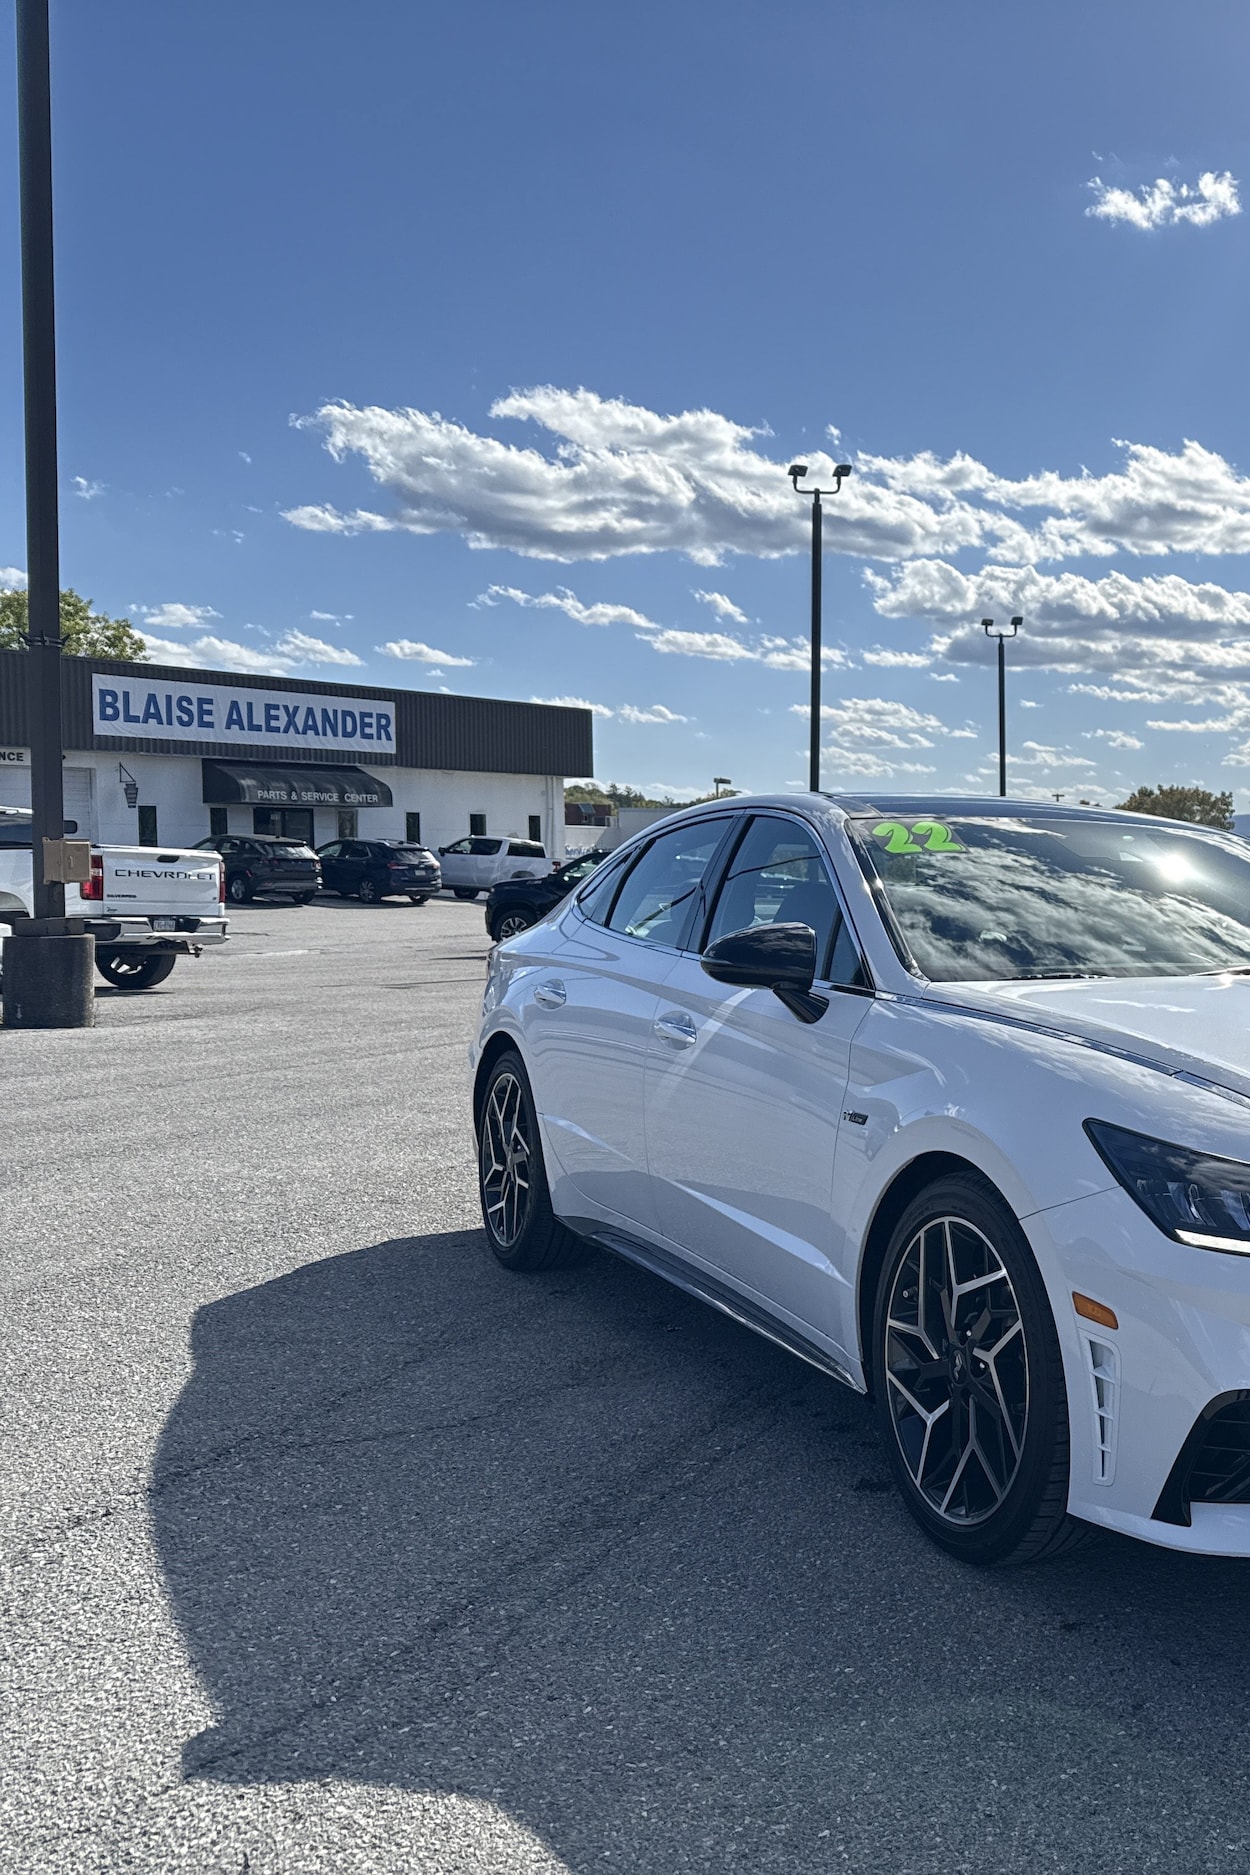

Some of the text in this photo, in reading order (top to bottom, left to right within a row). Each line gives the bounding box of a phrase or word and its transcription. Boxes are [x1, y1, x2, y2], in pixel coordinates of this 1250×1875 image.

[98, 688, 393, 741] BLAISE ALEXANDER
[257, 790, 379, 803] PARTS & SERVICE CENTER
[871, 820, 968, 855] 22
[114, 869, 215, 880] CHEVROLET
